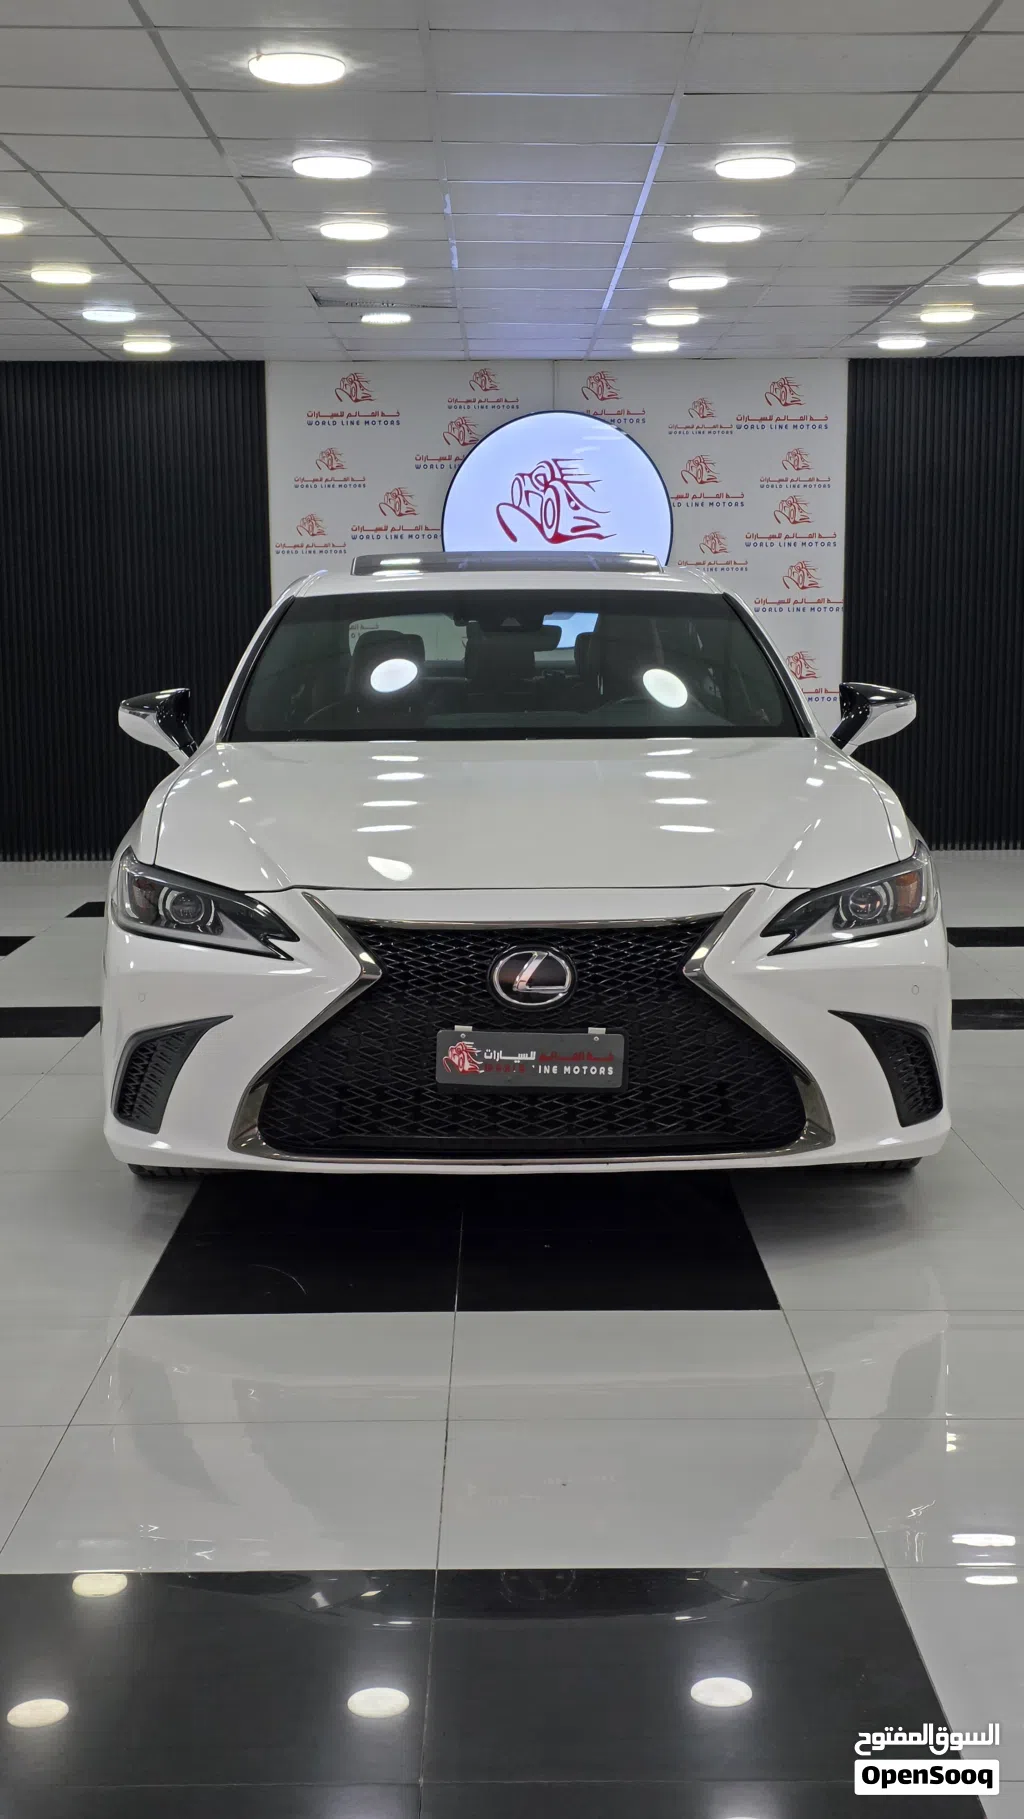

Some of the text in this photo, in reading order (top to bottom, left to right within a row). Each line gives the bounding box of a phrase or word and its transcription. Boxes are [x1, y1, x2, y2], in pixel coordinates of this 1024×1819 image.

[424, 524, 441, 532] ط
[483, 1049, 537, 1063] للسيارات
[531, 1064, 558, 1074] INE
[563, 1065, 614, 1075] MOTORS
